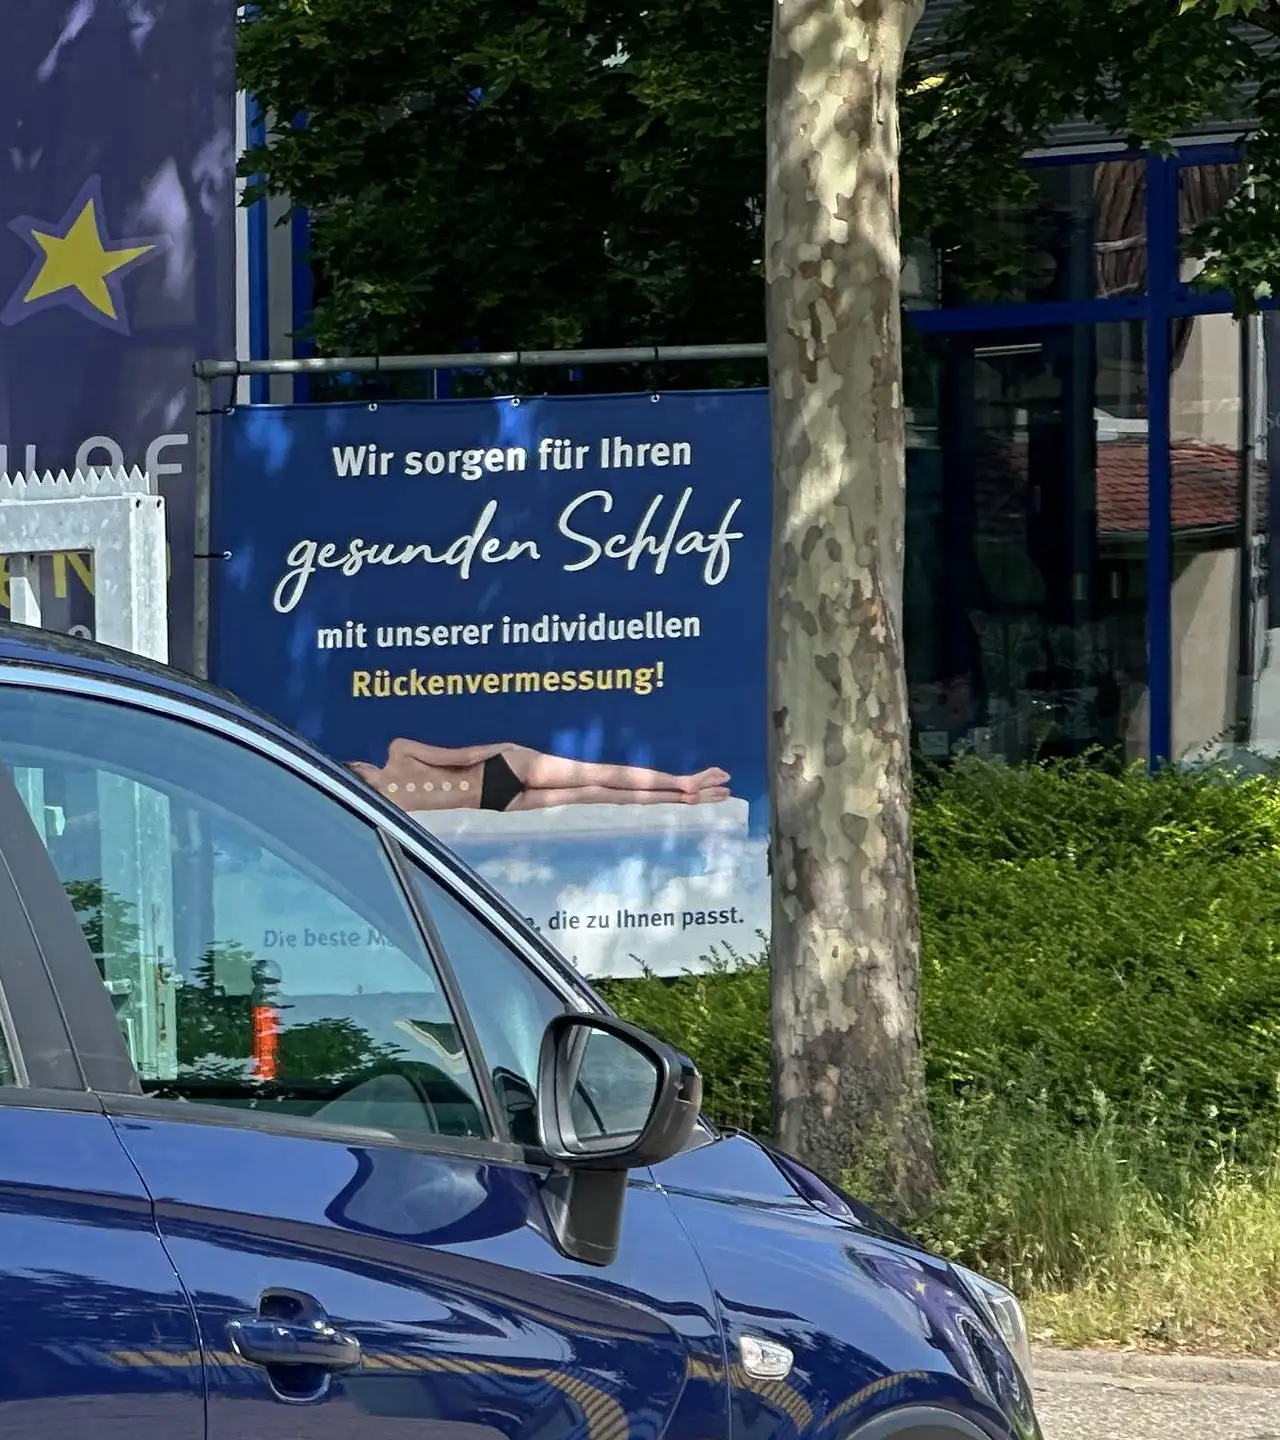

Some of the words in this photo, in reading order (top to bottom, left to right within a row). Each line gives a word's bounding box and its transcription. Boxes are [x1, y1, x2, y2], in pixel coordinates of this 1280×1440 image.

[332, 445, 395, 477] Wir
[404, 446, 527, 481] sorgen
[538, 437, 590, 471] für
[600, 438, 692, 469] Ihren
[273, 500, 540, 613] gesunden
[557, 487, 745, 586] Schlaf
[317, 620, 368, 649] mit
[377, 619, 494, 648] unserer
[502, 611, 701, 645] individuellen
[352, 661, 665, 697] Rückenvermessung!
[263, 929, 297, 947] Die
[303, 927, 361, 947] beste
[548, 911, 580, 931] die
[586, 914, 611, 930] zu
[616, 909, 676, 929] Ihnen
[681, 906, 745, 931] passt.
